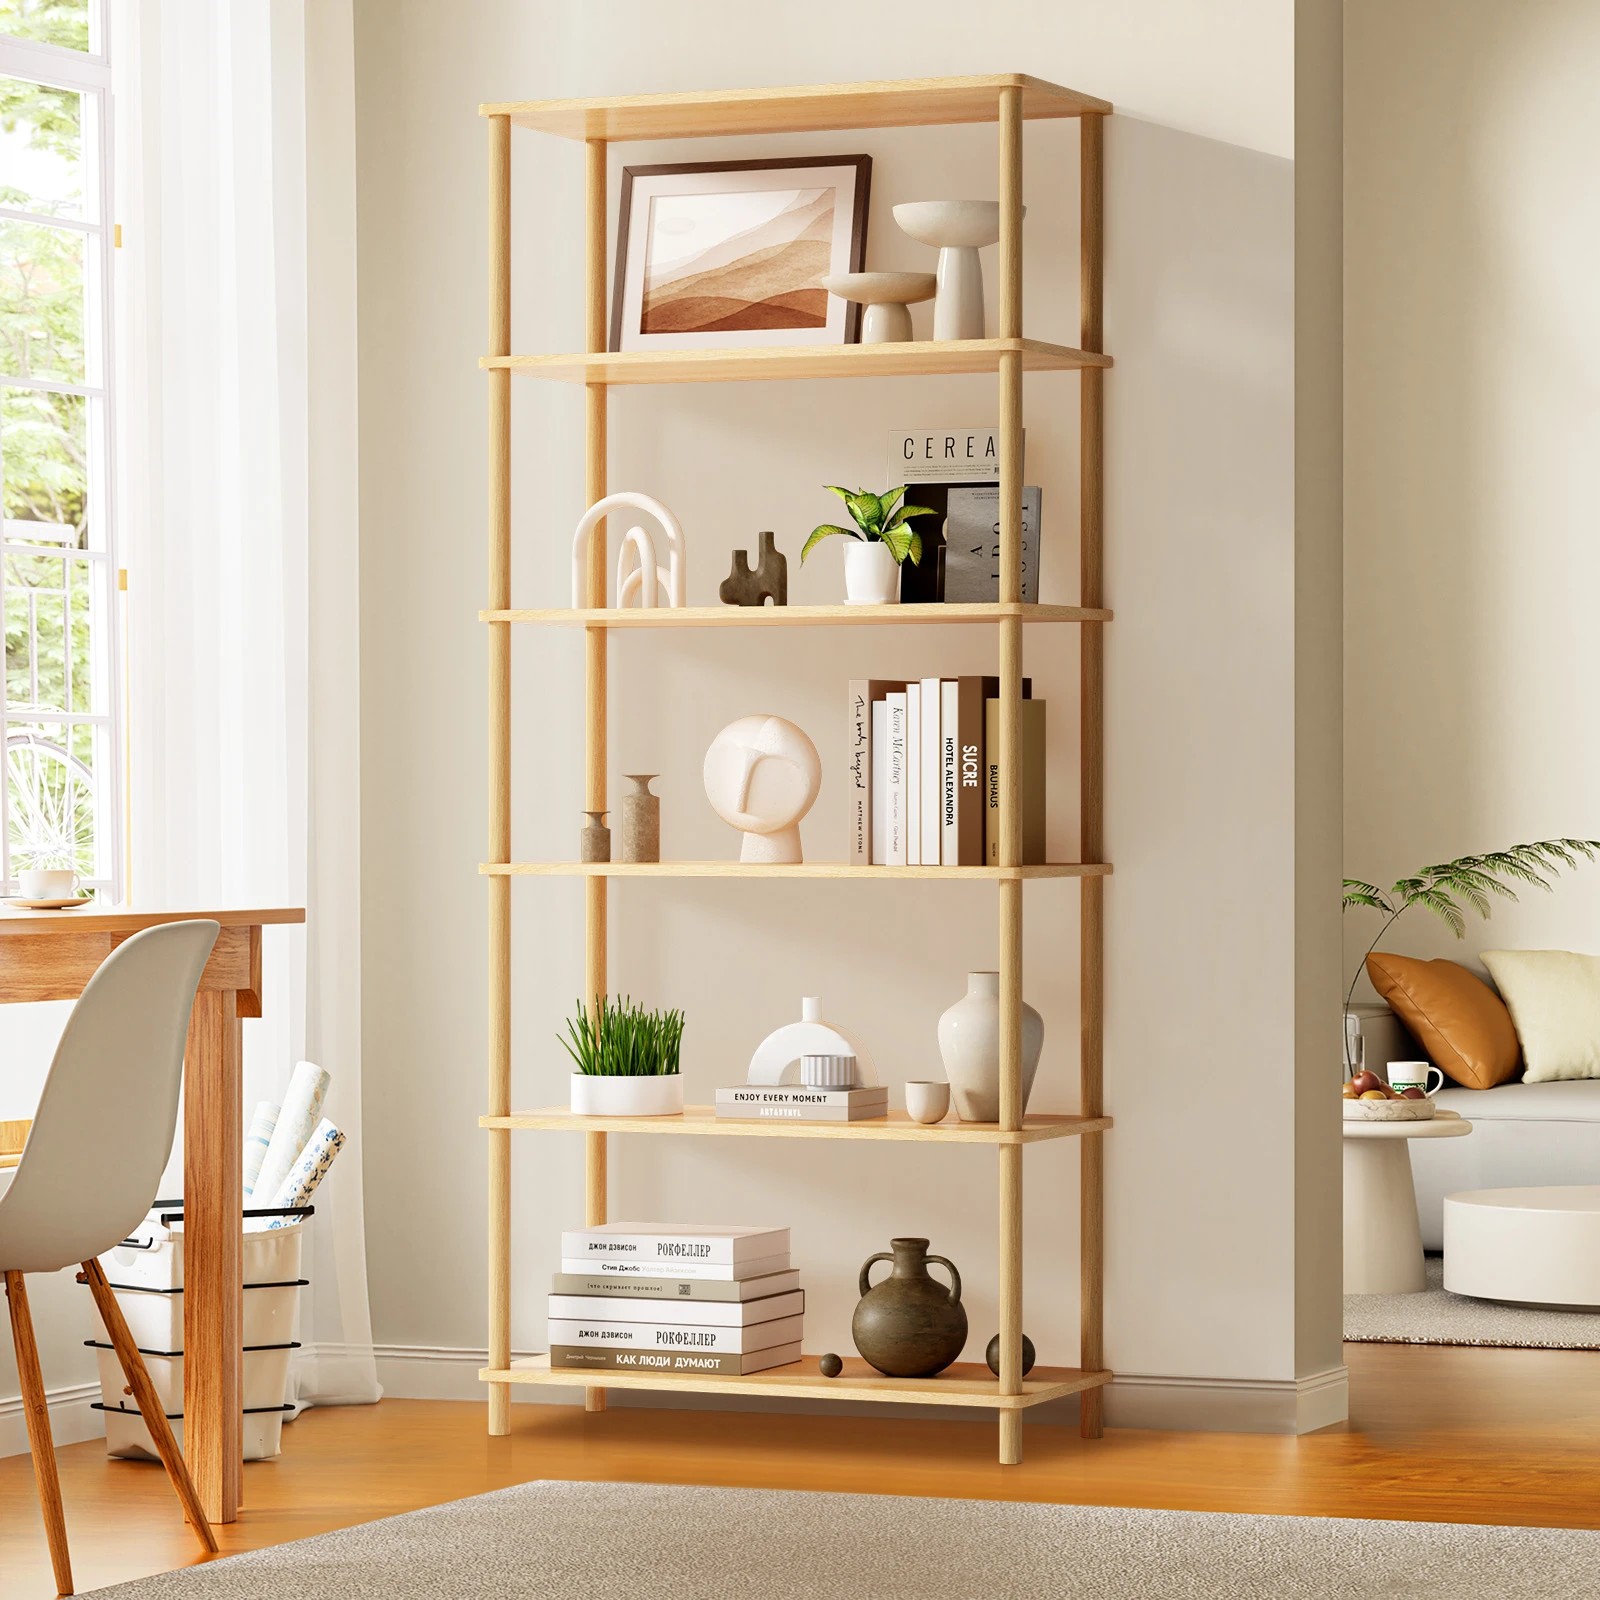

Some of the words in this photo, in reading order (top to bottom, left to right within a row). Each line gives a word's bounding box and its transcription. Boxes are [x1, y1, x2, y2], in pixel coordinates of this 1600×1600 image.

[903, 436, 996, 460] CEREA
[970, 545, 983, 557] A
[855, 695, 865, 718] The
[893, 707, 904, 734] Karen
[855, 722, 867, 746] body
[889, 736, 903, 785] McCartney
[945, 737, 954, 768] HOTEL
[962, 745, 978, 787] SUCRE
[945, 769, 954, 826] ALEXANDRA
[989, 764, 998, 808] BAUHAUS
[734, 1093, 761, 1101] ENJOY
[763, 1094, 789, 1102] EVERY
[792, 1095, 828, 1103] MOMENT
[608, 1243, 637, 1252] ДЭВИСОН
[657, 1242, 711, 1257] РОКФЕЛЛЕР
[618, 1264, 641, 1272] Джобс
[579, 1330, 599, 1338] ДЖОН
[601, 1330, 633, 1339] ДЭВИСОН
[656, 1331, 716, 1346] РОКФЕЛЛЕР
[616, 1354, 637, 1365] КАК
[638, 1355, 671, 1367] ЛЮДИ
[674, 1357, 721, 1369] ДУМАЮТ
